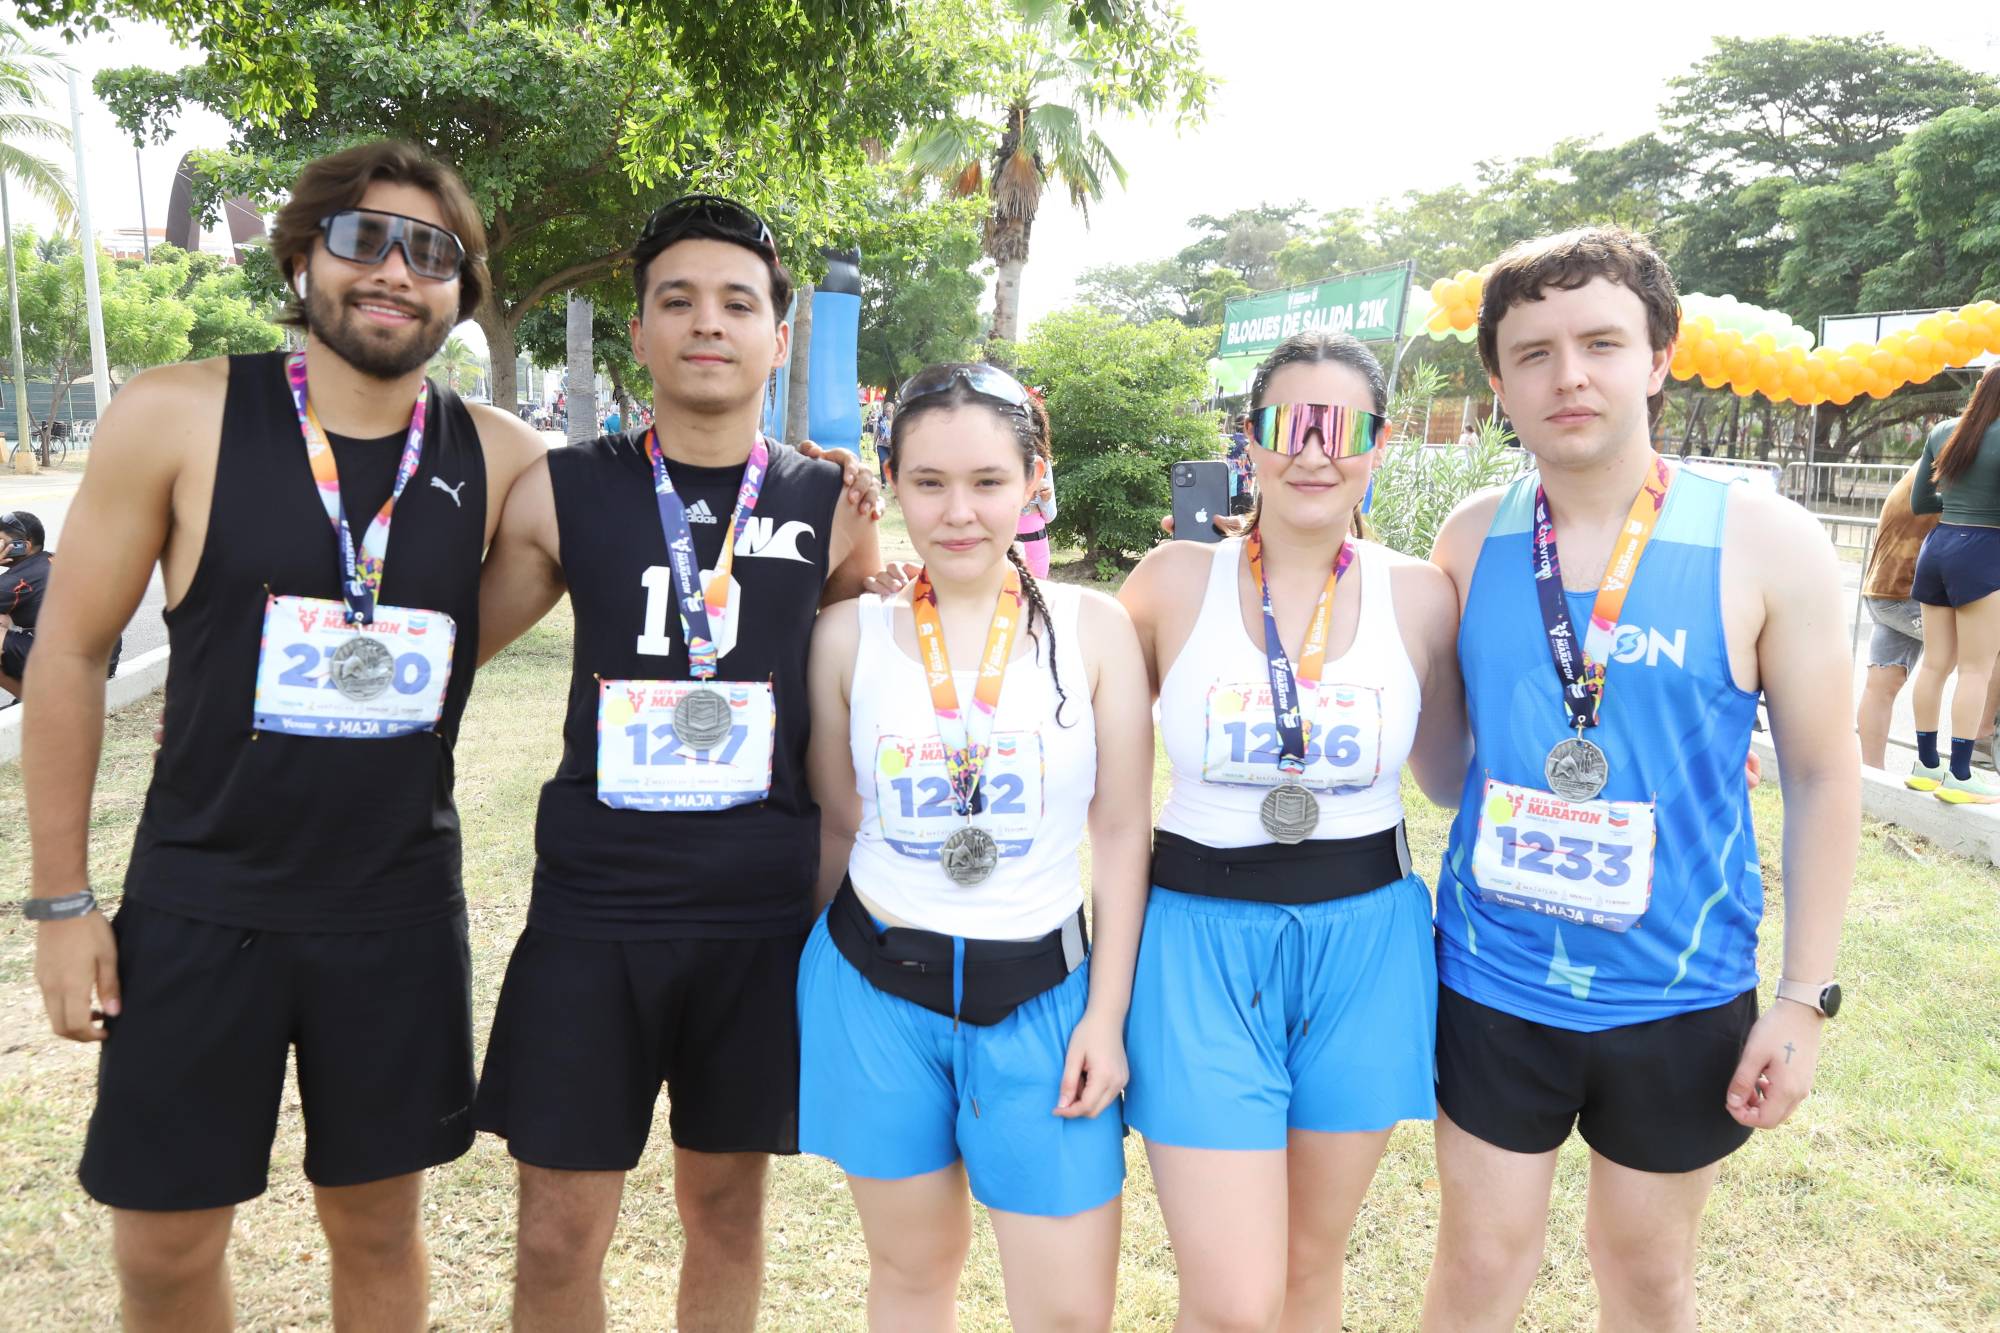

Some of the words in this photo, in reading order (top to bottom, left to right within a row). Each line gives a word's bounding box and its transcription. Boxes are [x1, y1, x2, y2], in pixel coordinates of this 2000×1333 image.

[1227, 315, 1281, 345] BLOQUES
[1282, 312, 1301, 338] DE
[1302, 303, 1353, 331] SALIDA
[1356, 298, 1388, 329] 21K
[339, 720, 380, 734] MAJA
[674, 794, 714, 808] MAJA
[1527, 803, 1602, 825] MARATON
[1495, 826, 1633, 887] 1233
[1545, 903, 1584, 922] MAJA
